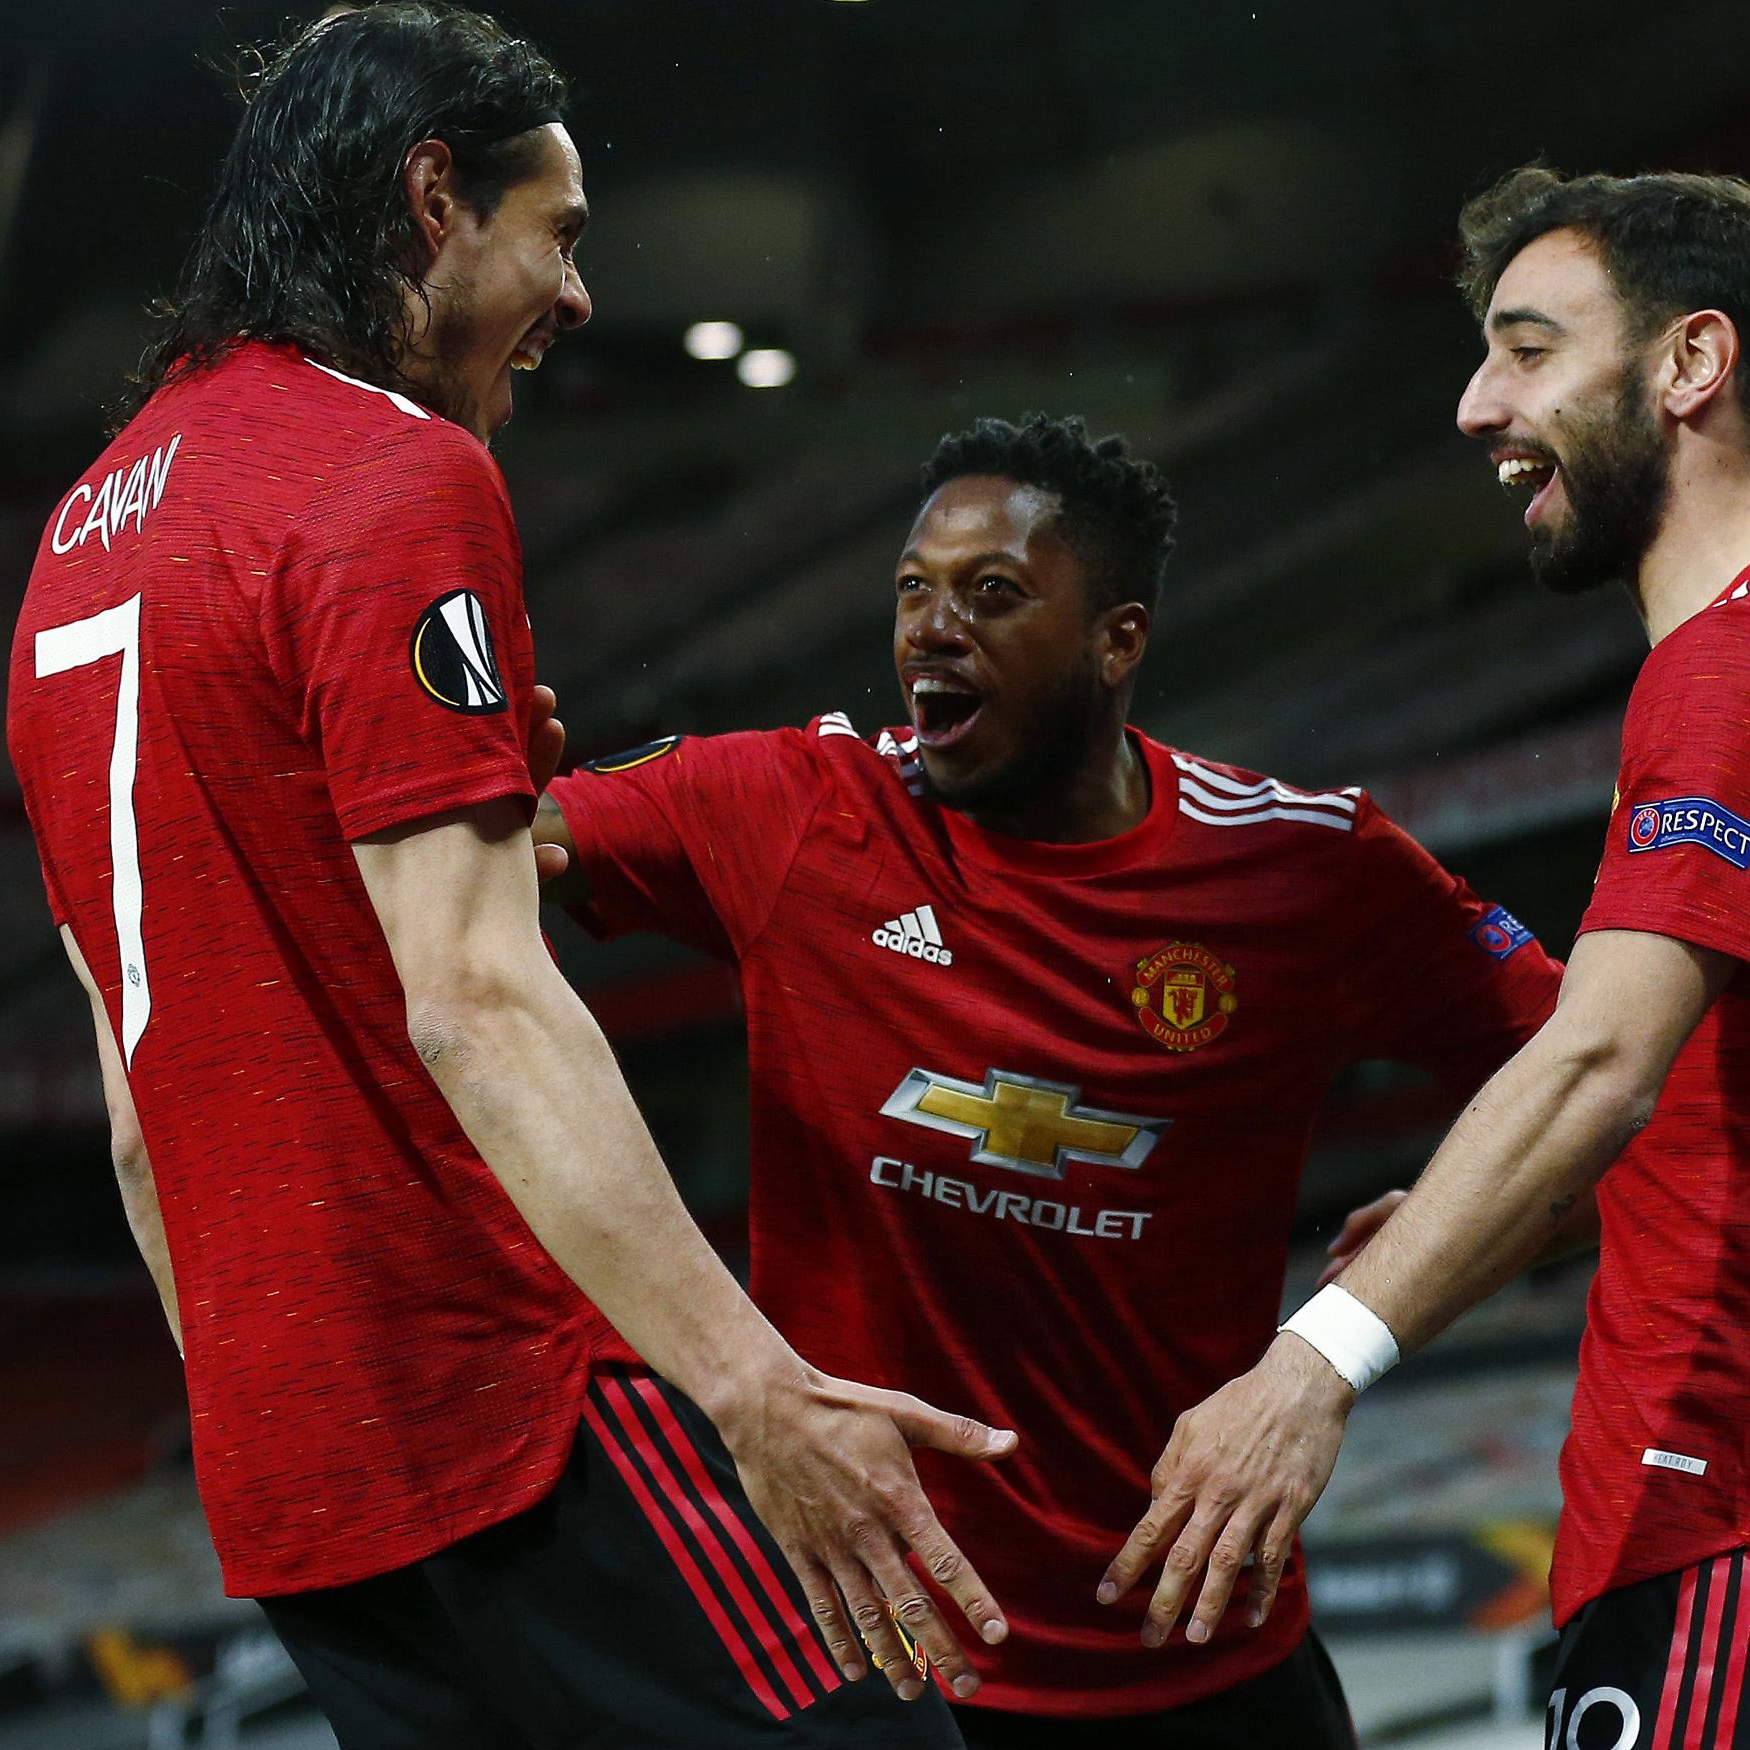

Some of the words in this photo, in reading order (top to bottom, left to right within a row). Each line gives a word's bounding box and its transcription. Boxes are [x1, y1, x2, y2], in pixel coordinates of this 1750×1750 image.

[35, 591, 152, 1072] 7
[1661, 809, 1750, 855] RESPECT
[871, 928, 953, 967] adidas
[1144, 949, 1229, 985] MANCHESTER
[1153, 1022, 1212, 1044] UNITED
[869, 1155, 1153, 1241] CHEVROLET
[1548, 1686, 1641, 1750] 10
